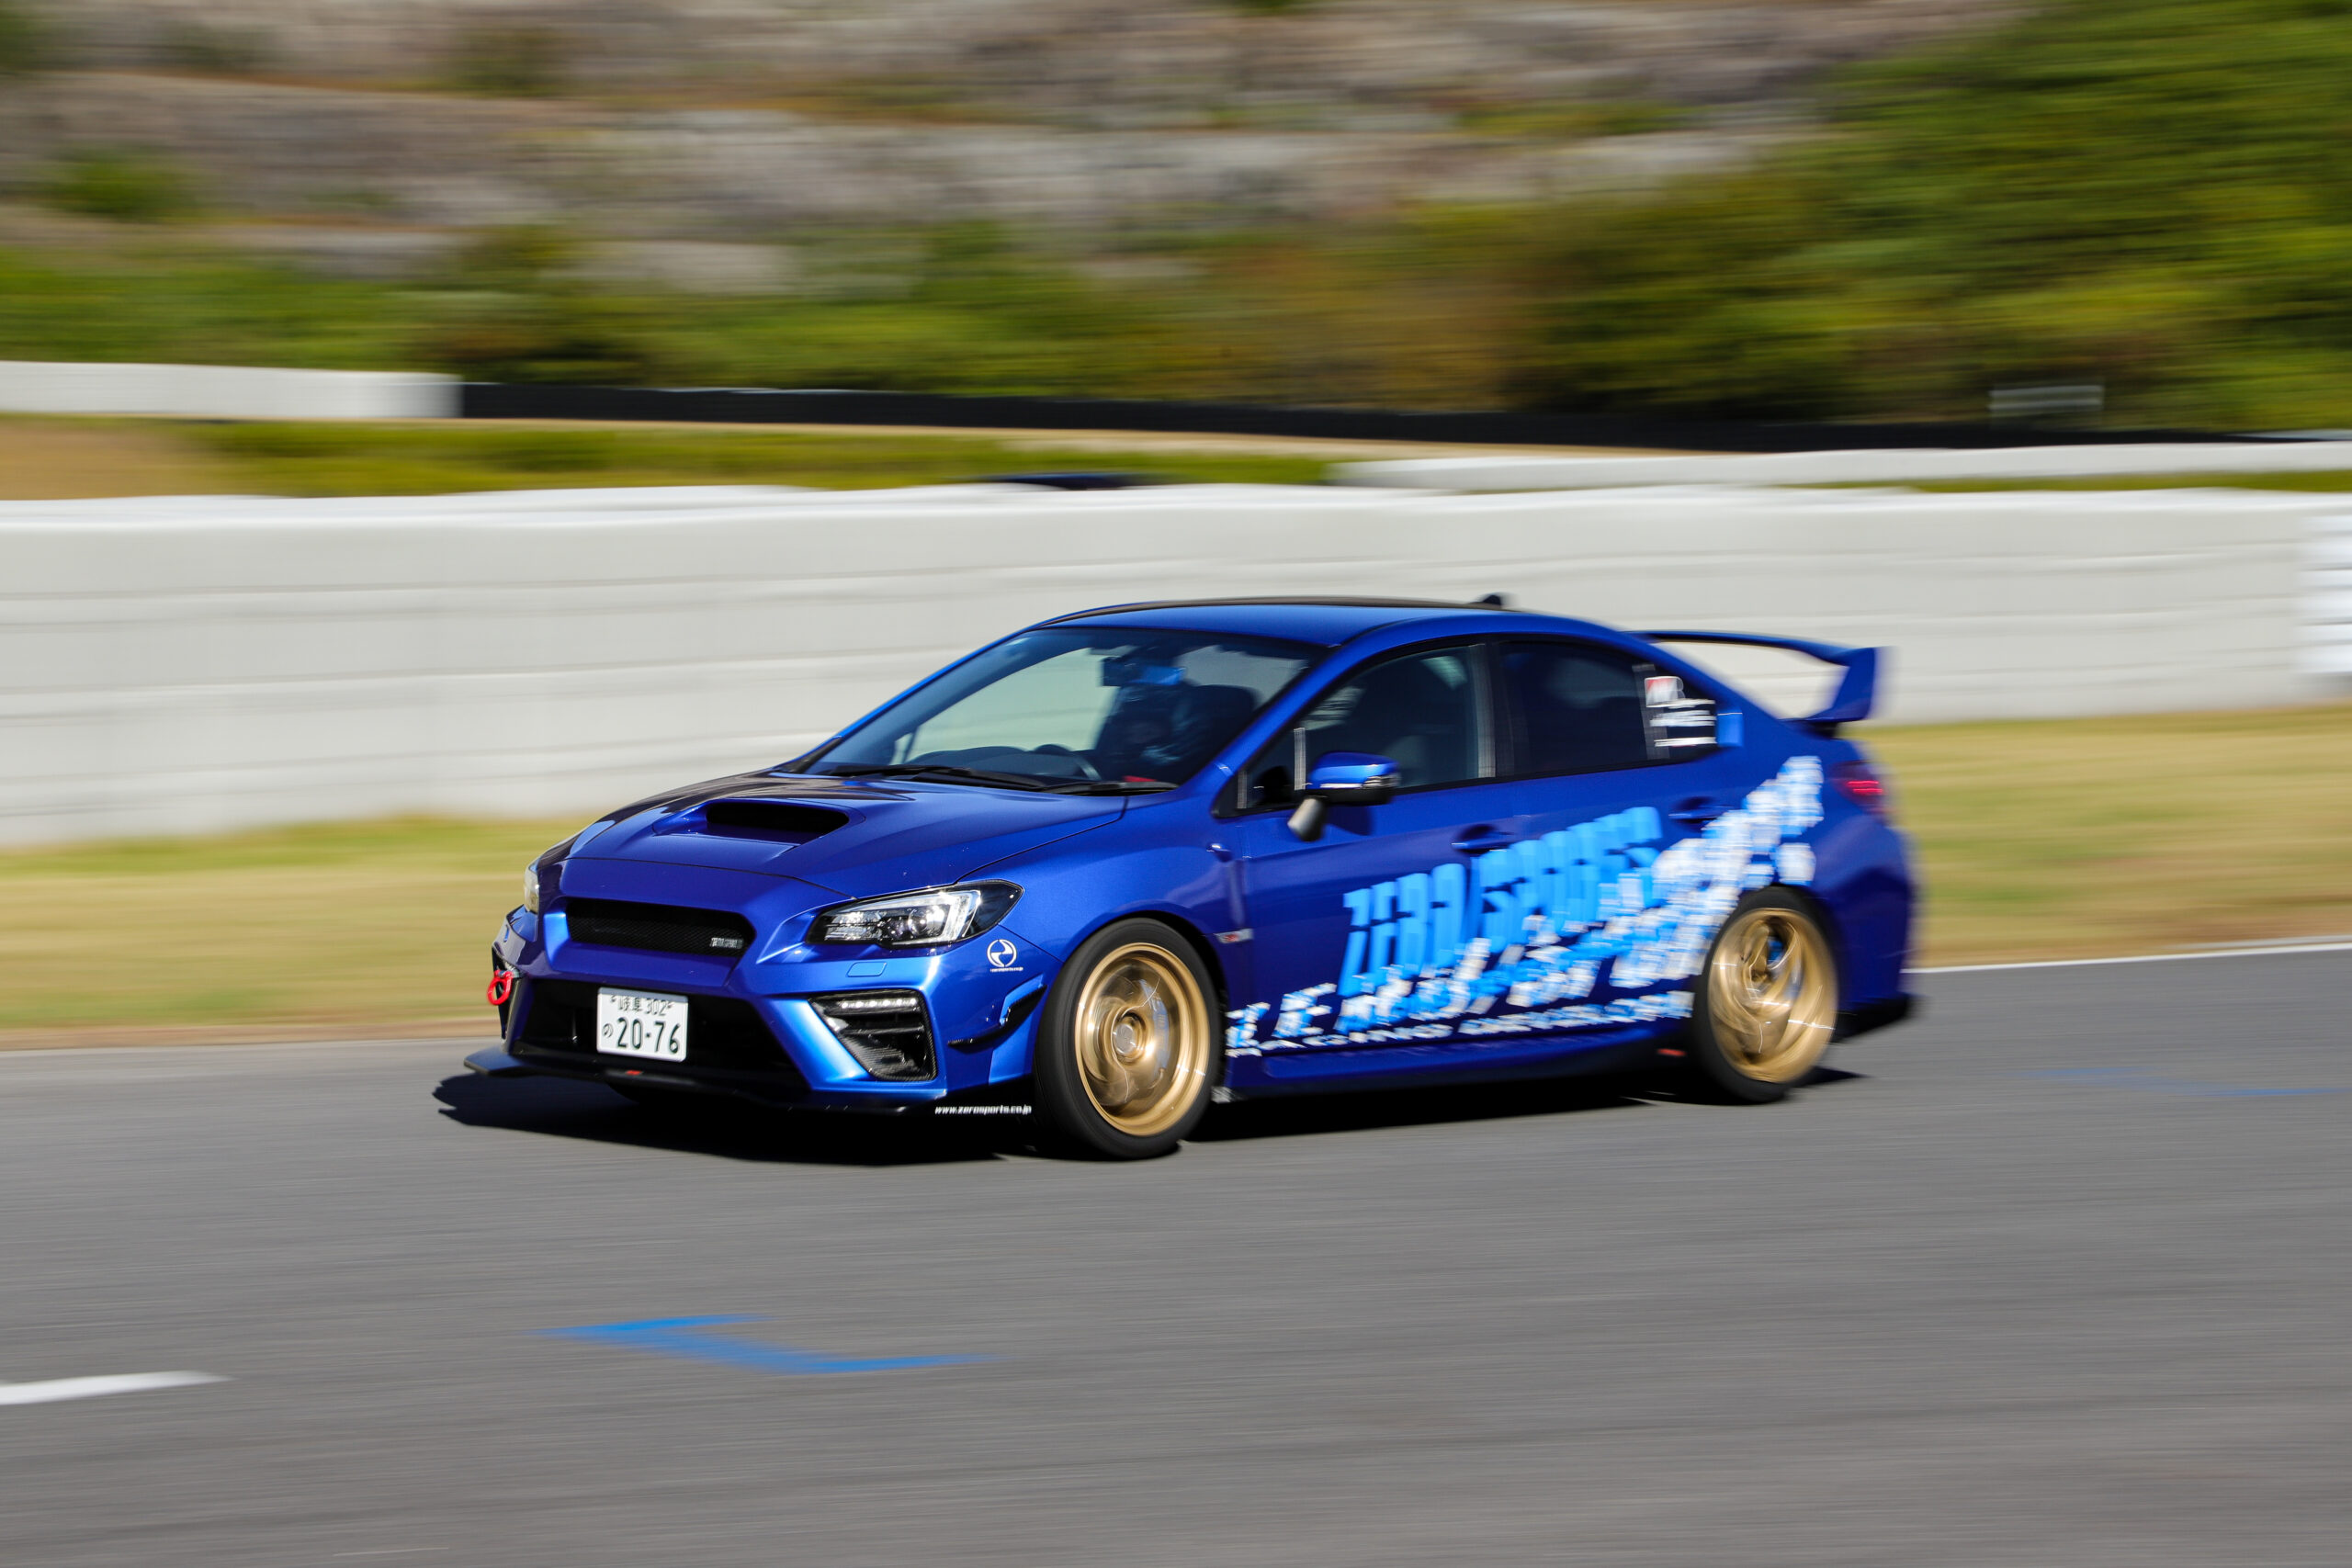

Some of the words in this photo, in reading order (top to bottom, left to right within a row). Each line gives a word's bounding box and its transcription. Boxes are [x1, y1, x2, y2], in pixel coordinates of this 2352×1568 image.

[645, 998, 668, 1017] 302
[602, 1022, 614, 1039] の
[934, 1104, 1032, 1115] www.zerosports.co.jp
